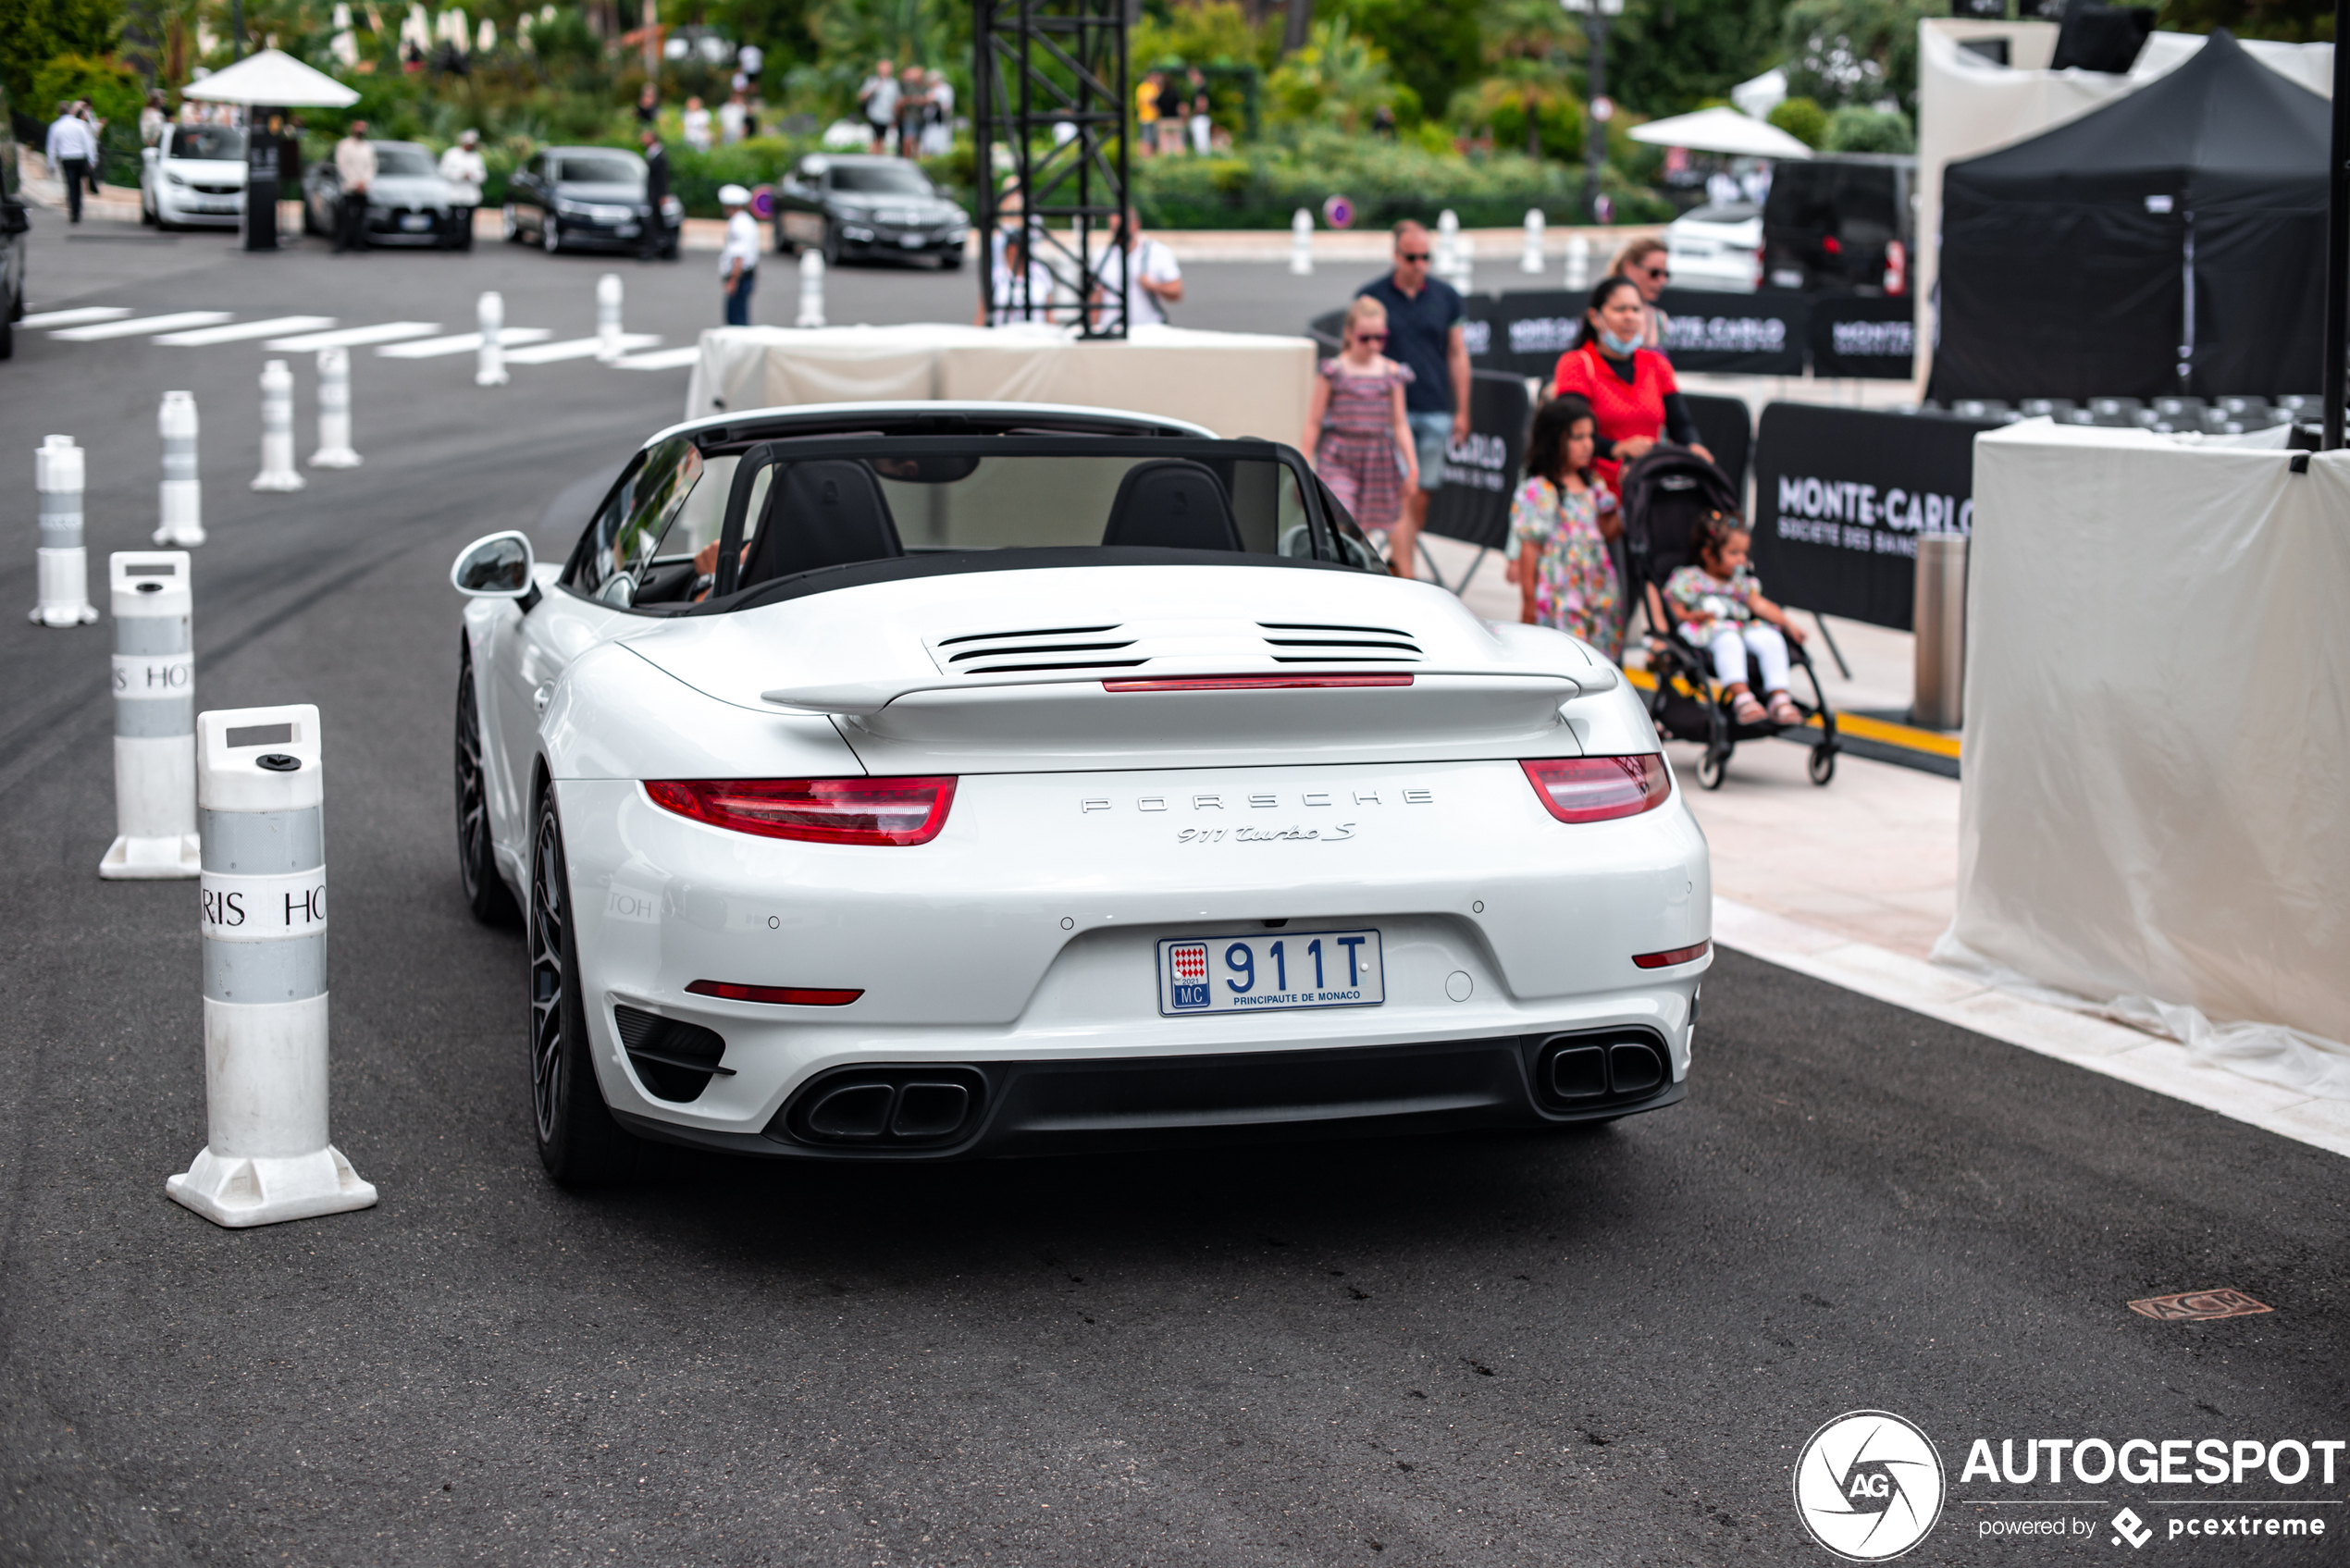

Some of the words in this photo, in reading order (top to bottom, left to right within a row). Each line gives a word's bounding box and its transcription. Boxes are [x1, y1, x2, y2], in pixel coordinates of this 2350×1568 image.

[147, 662, 192, 689] HO
[1082, 788, 1433, 813] PORSCHE
[1178, 826, 1229, 843] 911
[1321, 821, 1356, 841] S
[202, 888, 245, 926] RIS
[1225, 936, 1366, 994] 911T
[1181, 986, 1203, 1003] MC
[1233, 994, 1298, 1006] PRINCIPAUTE
[1302, 993, 1315, 1002] DE
[1318, 991, 1361, 1001] MONACO
[2151, 1292, 2257, 1317] ACM
